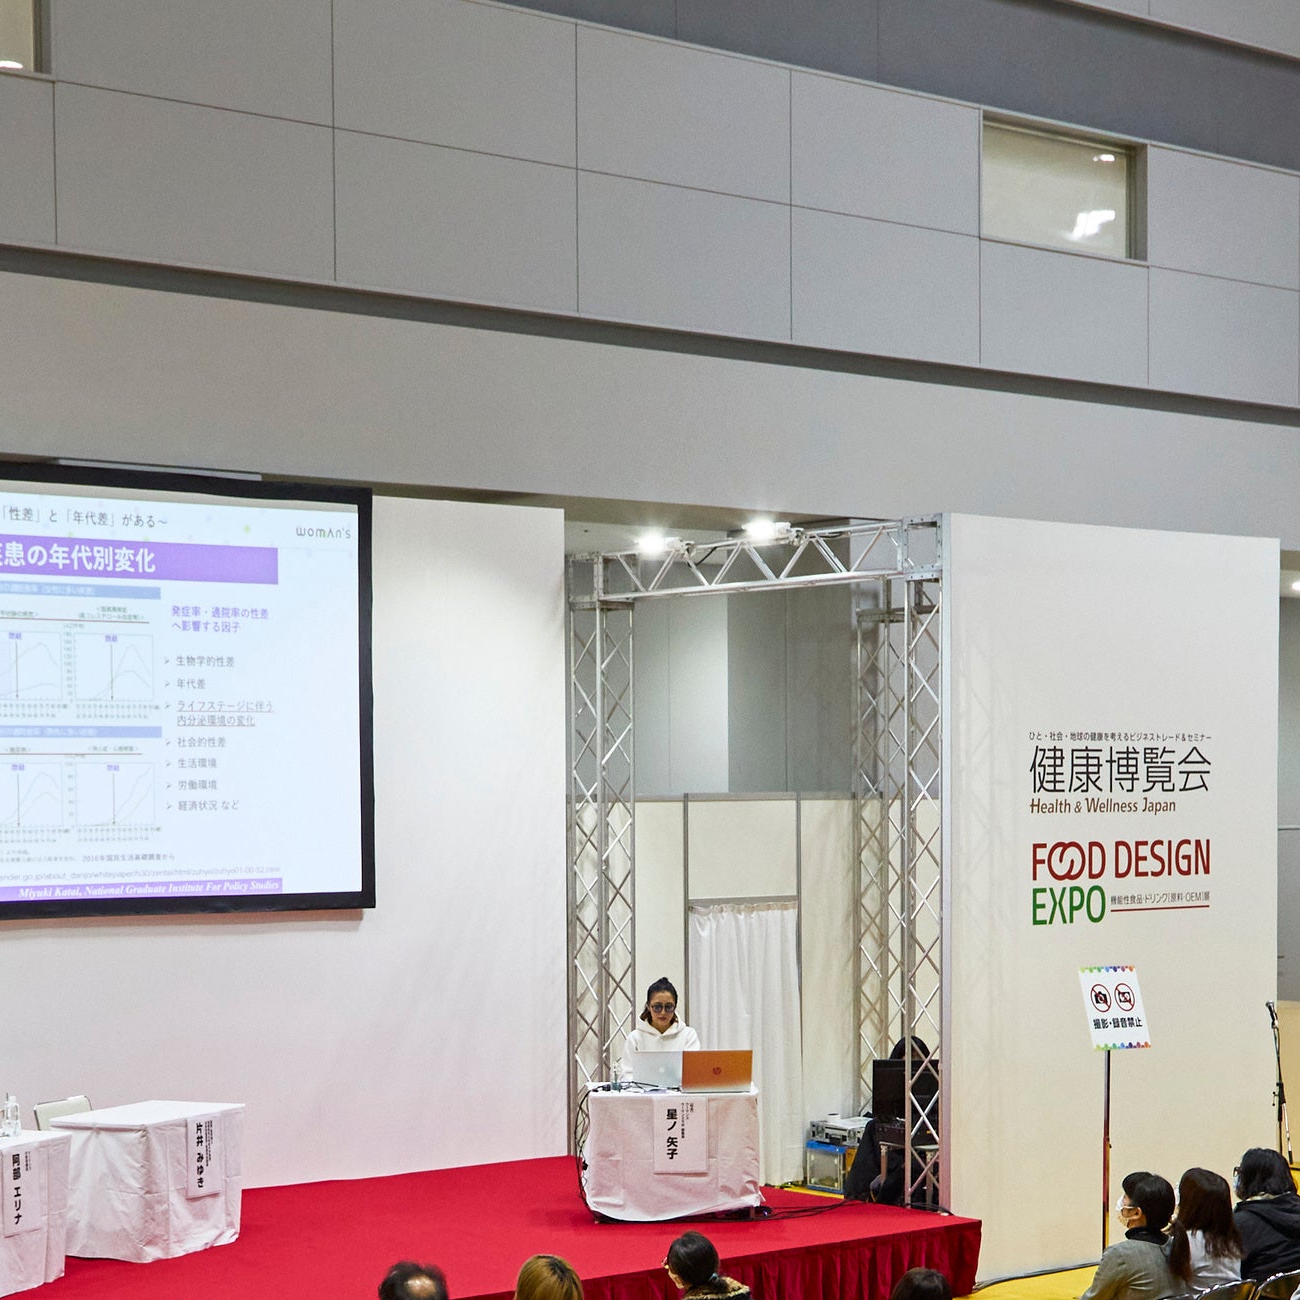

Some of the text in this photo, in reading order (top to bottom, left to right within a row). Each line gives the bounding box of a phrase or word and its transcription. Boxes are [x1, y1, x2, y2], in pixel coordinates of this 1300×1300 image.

[176, 656, 235, 667] 生物学的性差
[176, 678, 206, 689] 年代差
[178, 700, 273, 711] ライフステージに伴う
[177, 714, 255, 726] 内分泌環境の変化
[178, 737, 226, 748] 社会的性差
[178, 758, 217, 768] 生活環境
[1029, 745, 1211, 793] 健康博覧会
[178, 780, 218, 790] 労働環境
[178, 800, 240, 811] 経済状況 など
[1030, 796, 1176, 815] Health & Wellness Japan
[1032, 838, 1210, 881] FOOD DESIGN
[19, 887, 52, 899] Miyuki
[85, 884, 124, 896] National
[125, 882, 166, 894] Graduate
[168, 883, 203, 893] Institute
[205, 882, 221, 892] For
[223, 881, 248, 893] Policy
[249, 880, 279, 890] Studies
[1032, 885, 1106, 925] EXPO
[1093, 1016, 1143, 1029] 撮影・録音禁止
[666, 1108, 678, 1160] 星ノ 矢子
[196, 1122, 204, 1188] 片井 みゆき
[12, 1153, 22, 1225] 阿部 エリナ
